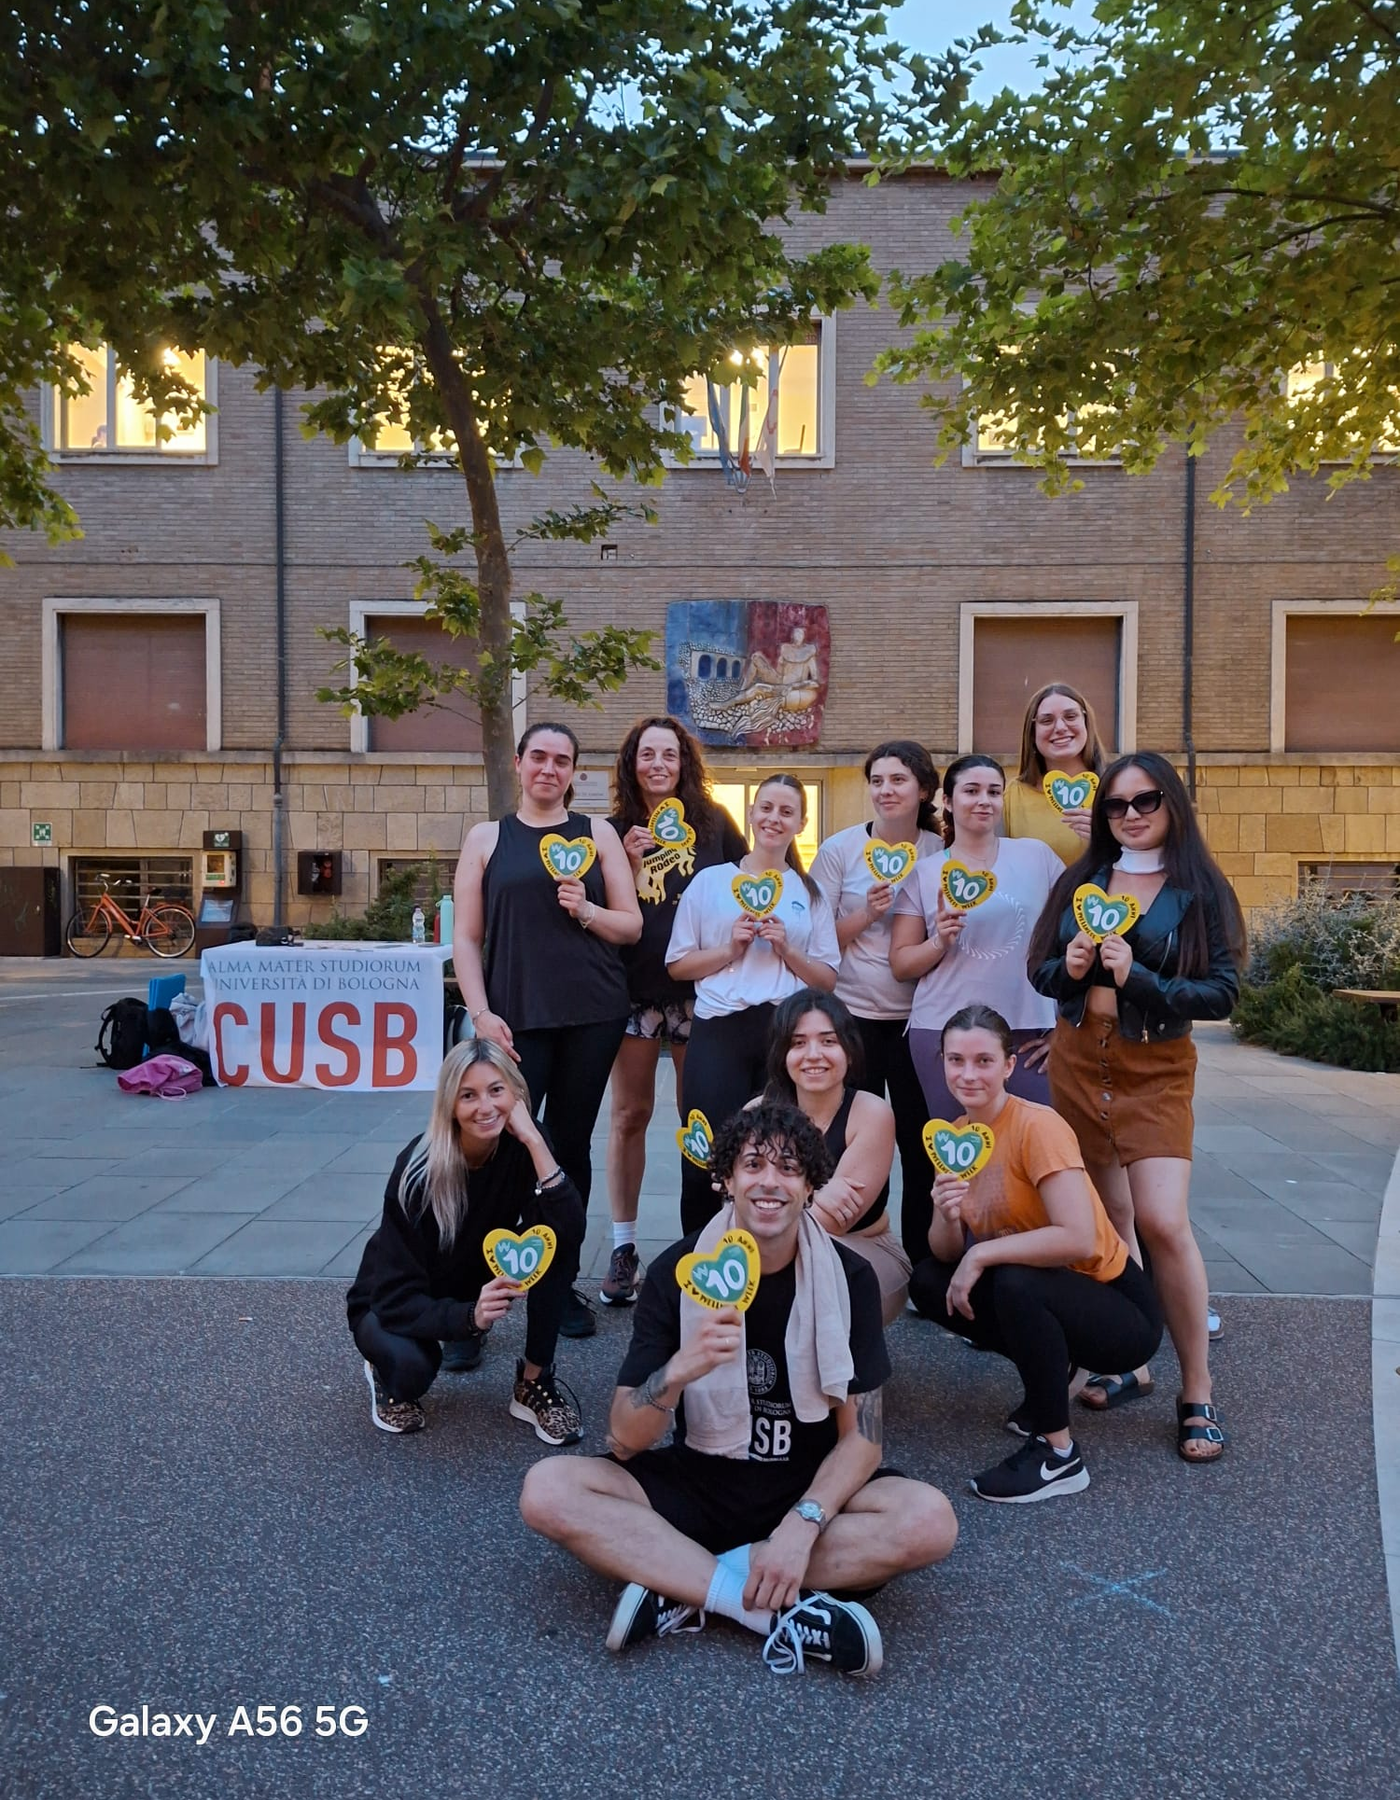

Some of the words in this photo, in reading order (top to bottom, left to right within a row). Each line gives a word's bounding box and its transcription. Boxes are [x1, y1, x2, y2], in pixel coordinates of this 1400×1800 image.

[1057, 786, 1085, 806] 10
[657, 815, 679, 840] 10
[554, 850, 582, 871] 10
[877, 854, 903, 875] 10
[746, 885, 772, 907] 10
[952, 877, 980, 901] 10
[1088, 904, 1120, 931] 10
[208, 960, 253, 973] ALMA
[258, 959, 315, 973] MATER
[320, 959, 421, 973] STUDIORUM
[313, 977, 331, 990] DI
[338, 977, 420, 991] BOLOGNA
[213, 1001, 418, 1088] CUSB
[690, 1130, 709, 1159] 10
[941, 1140, 976, 1167] 10
[960, 1165, 978, 1179] WEEK
[498, 1241, 511, 1252] W
[503, 1247, 538, 1274] 10
[525, 1269, 542, 1286] WEEK
[692, 1264, 709, 1280] W
[706, 1259, 746, 1298] 10
[742, 1280, 755, 1304] WEEK
[754, 1416, 792, 1456] SB
